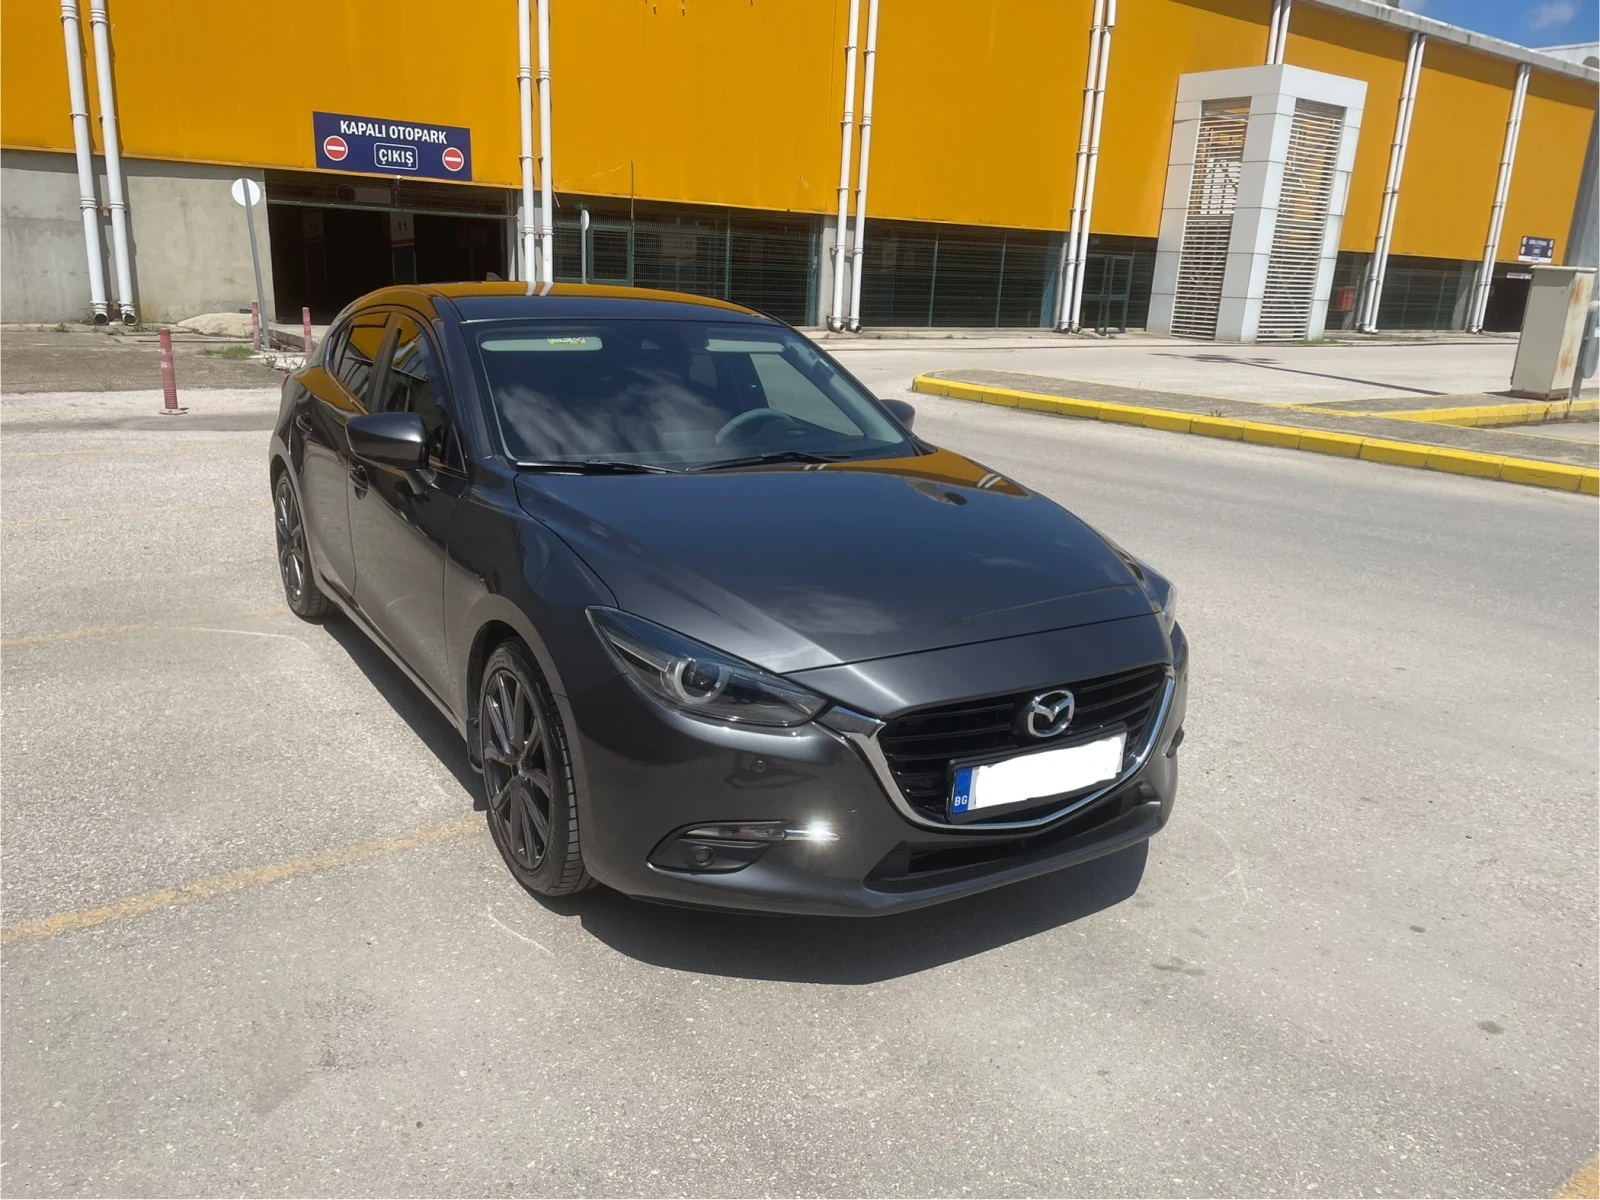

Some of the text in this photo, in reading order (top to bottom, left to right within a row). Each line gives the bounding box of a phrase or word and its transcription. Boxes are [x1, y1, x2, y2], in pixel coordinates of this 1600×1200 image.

[340, 120, 447, 144] KAPALI OTOPARK
[378, 149, 414, 167] ÇIKIŞ
[397, 220, 408, 232] 11
[954, 795, 968, 807] BG
